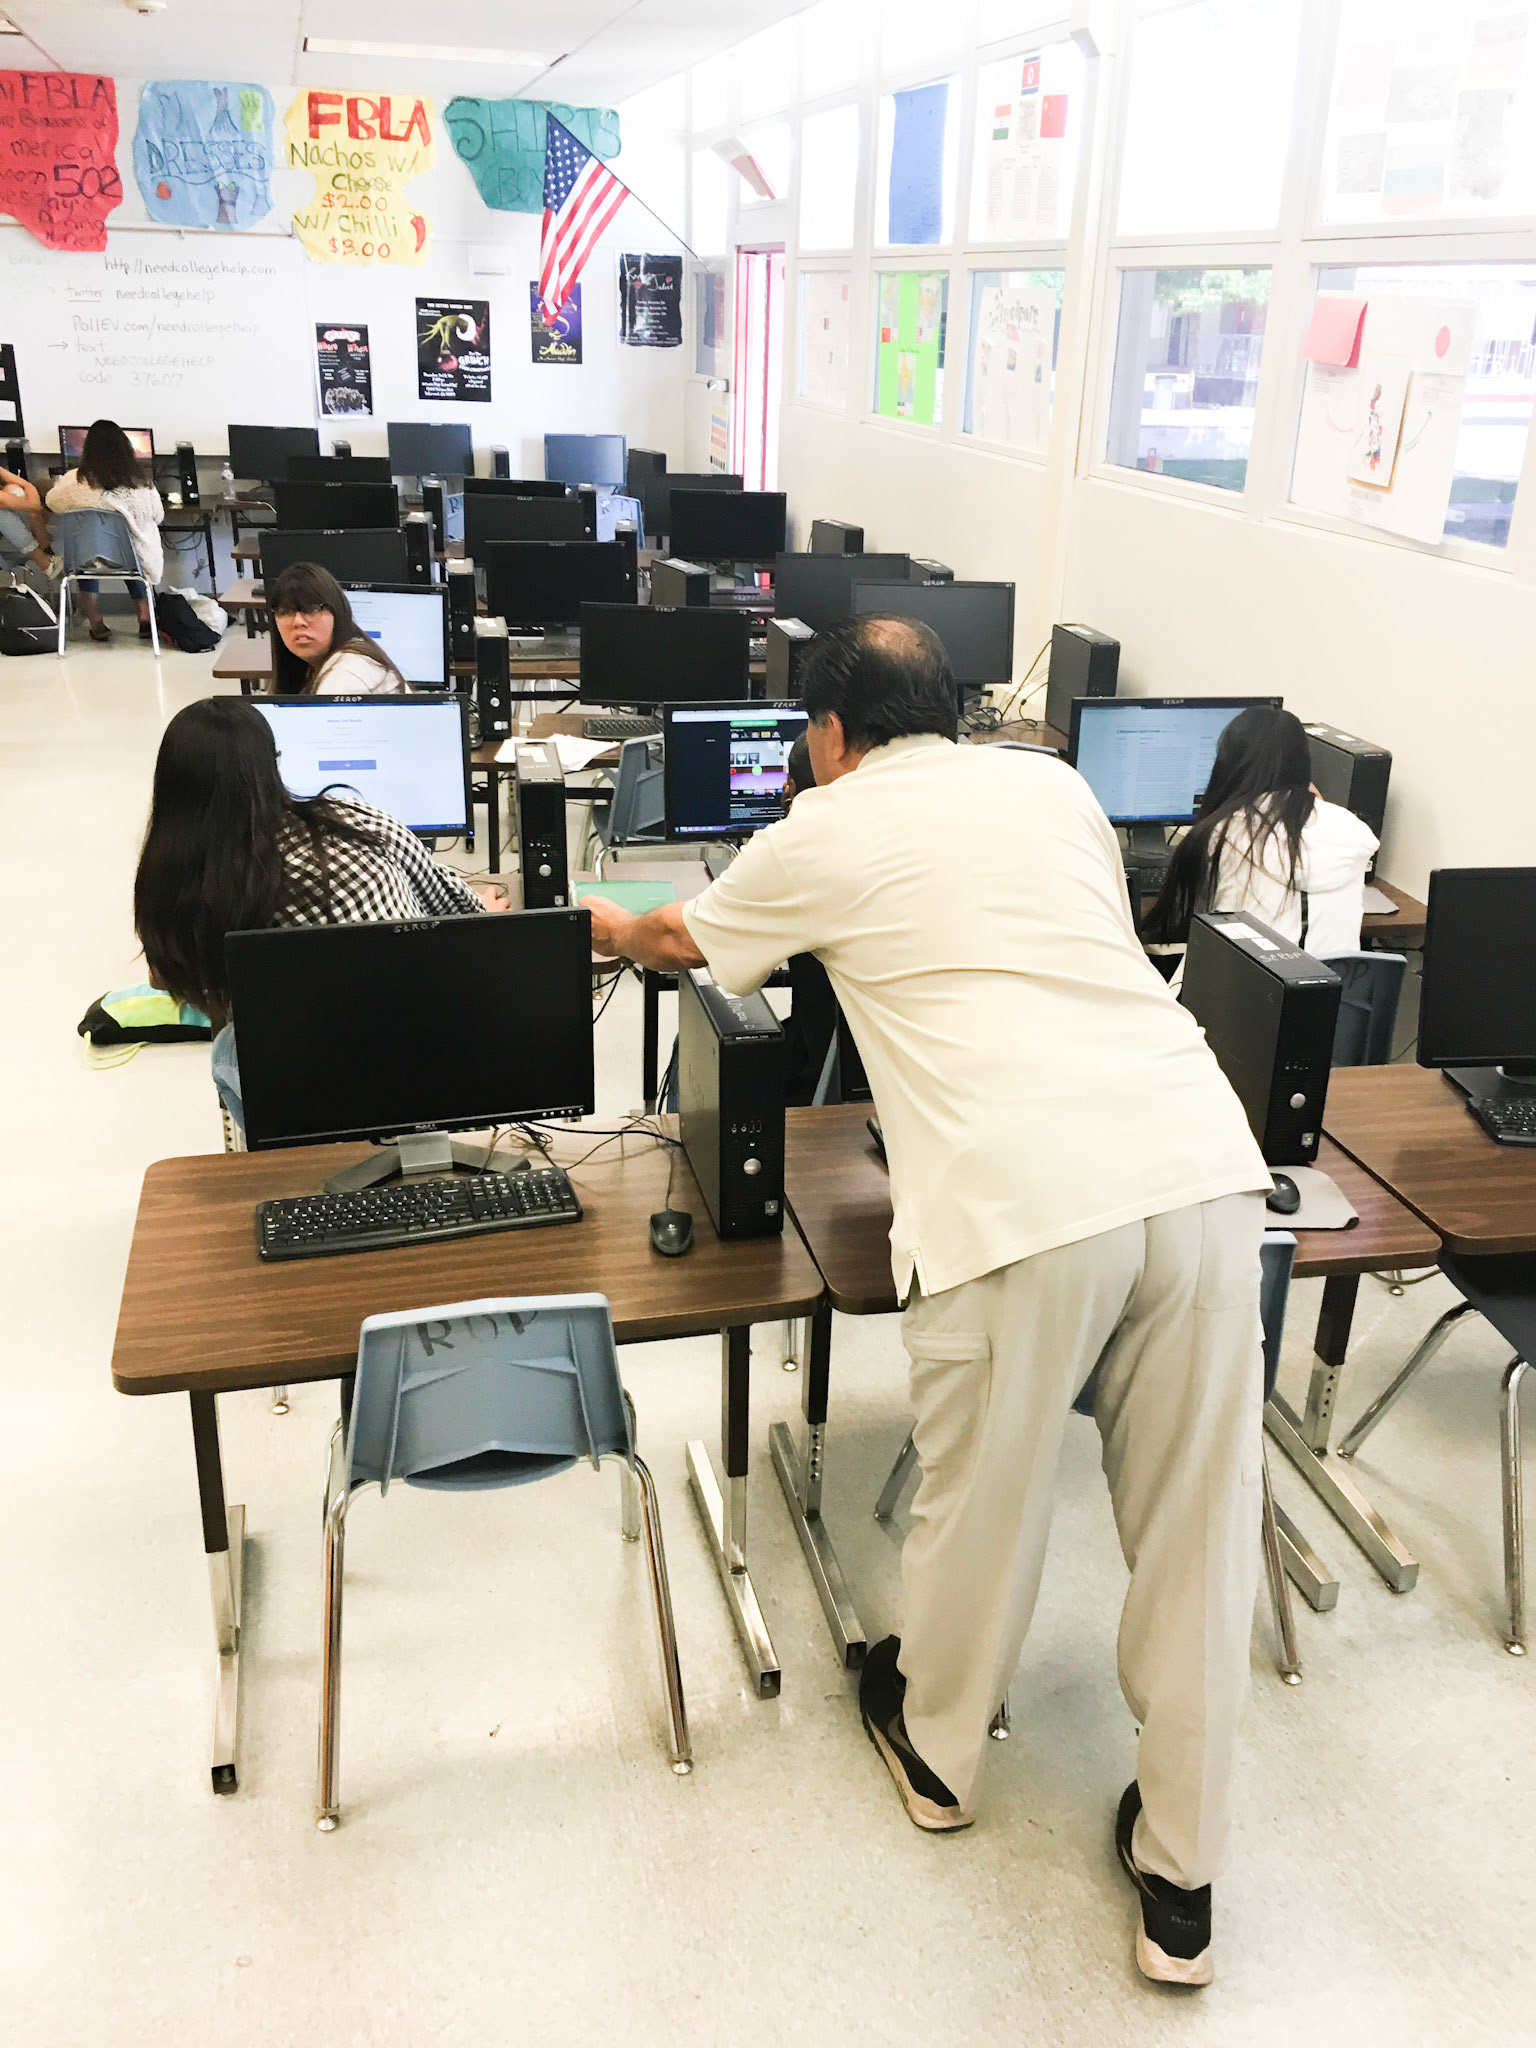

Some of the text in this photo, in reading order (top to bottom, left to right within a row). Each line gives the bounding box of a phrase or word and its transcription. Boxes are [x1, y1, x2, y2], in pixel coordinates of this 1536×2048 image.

[20, 73, 116, 114] FBLA
[307, 91, 432, 148] FBLA
[146, 138, 267, 177] DRESSES
[290, 141, 376, 170] Nachos
[53, 164, 123, 199] 502
[321, 192, 388, 212] $2.00
[338, 214, 399, 238] Chilli
[328, 235, 391, 259] $3.00
[333, 695, 363, 703] SEROP
[393, 920, 441, 934] SEROP
